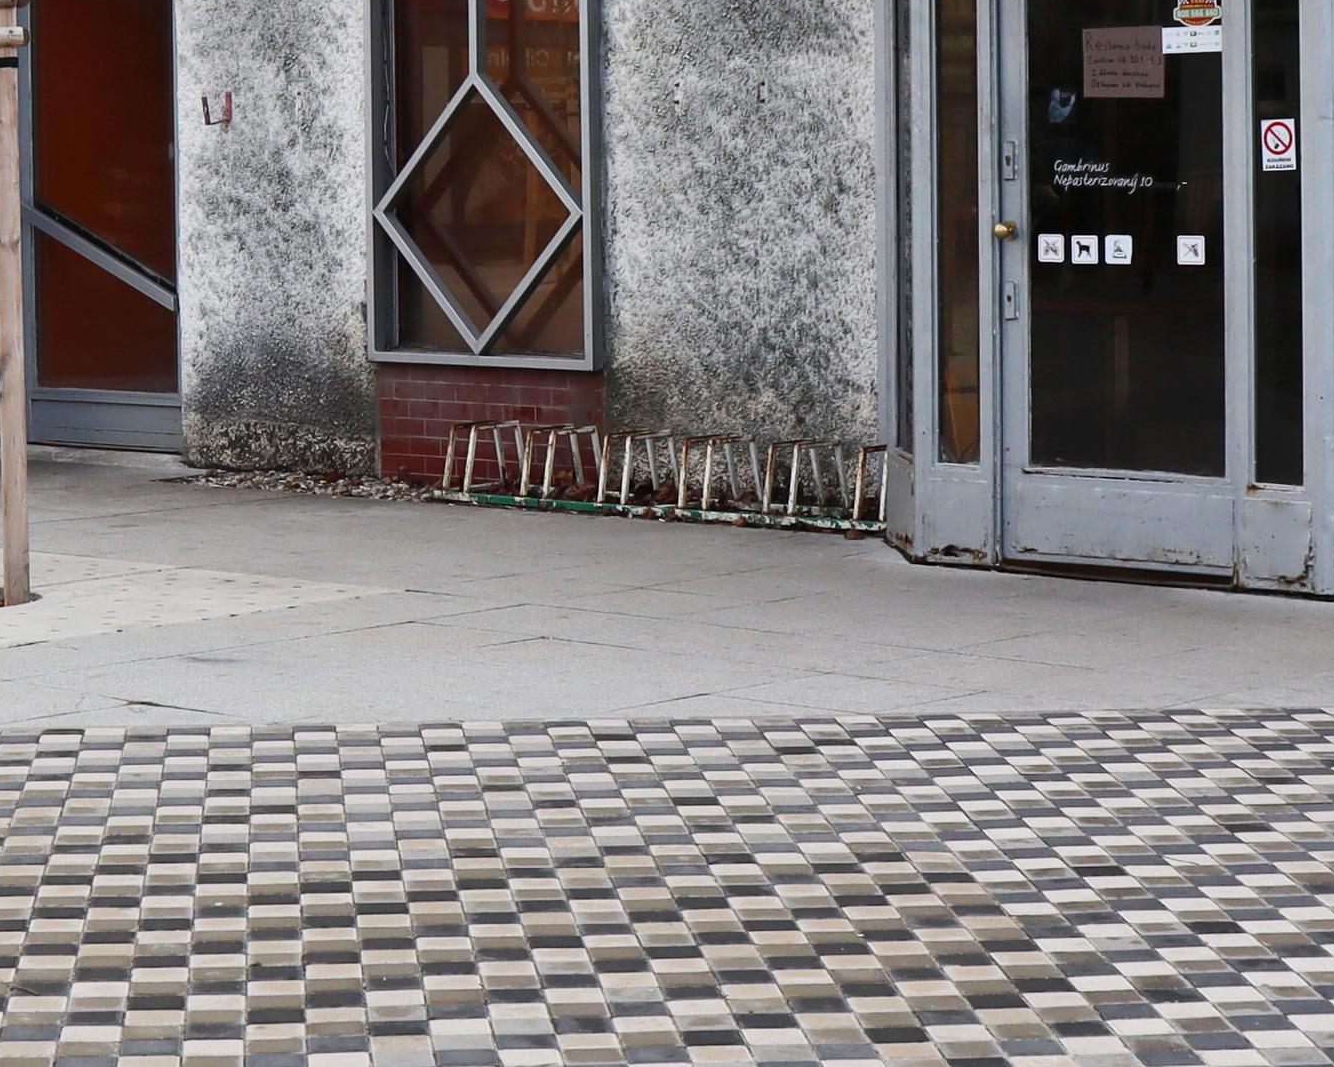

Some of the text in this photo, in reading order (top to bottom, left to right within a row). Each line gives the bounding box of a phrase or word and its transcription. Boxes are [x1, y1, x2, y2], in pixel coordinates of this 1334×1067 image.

[1053, 158, 1110, 173] Gambrinus
[1053, 173, 1139, 194] Nepasterizovaný
[1140, 177, 1153, 187] 10
